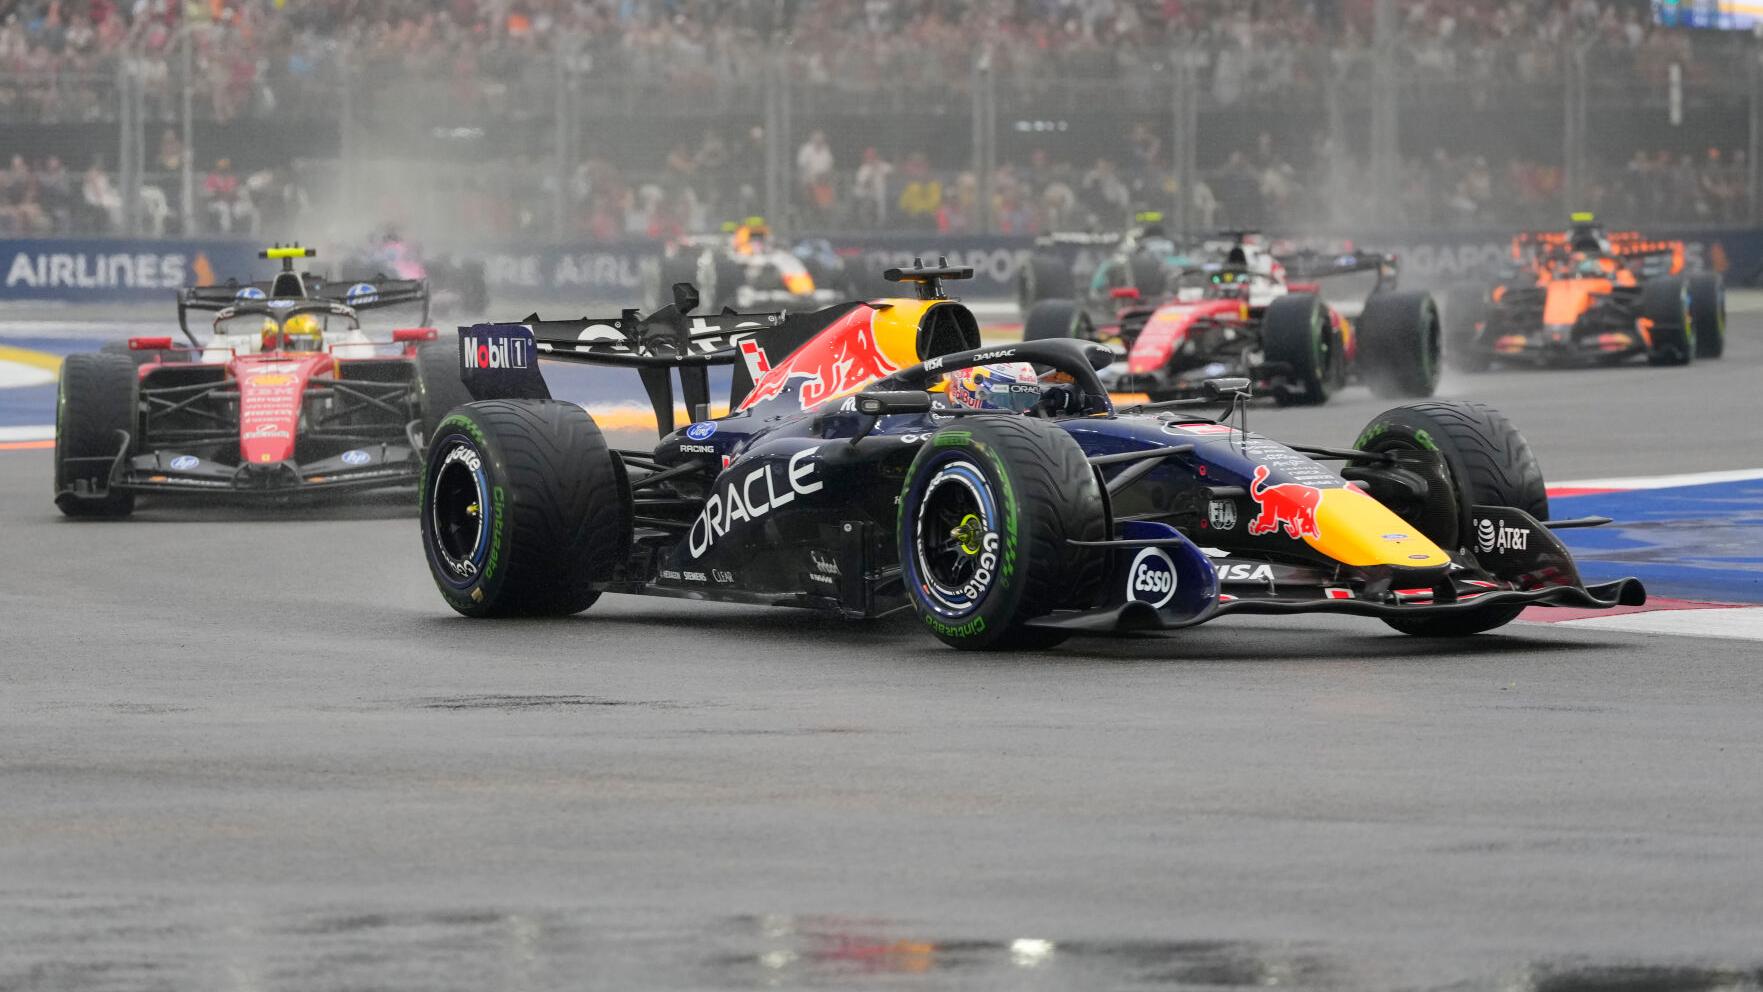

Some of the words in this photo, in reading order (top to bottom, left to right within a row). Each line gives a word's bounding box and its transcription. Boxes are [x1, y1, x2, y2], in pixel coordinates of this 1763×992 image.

[6, 252, 187, 288] AIRLINES
[464, 336, 510, 369] Mobil
[923, 357, 943, 371] VISA
[973, 348, 1016, 361] DAMAC
[680, 445, 714, 453] RACING
[689, 446, 824, 559] ORACLE
[1497, 527, 1530, 550] AT&T
[1135, 563, 1172, 593] Esso
